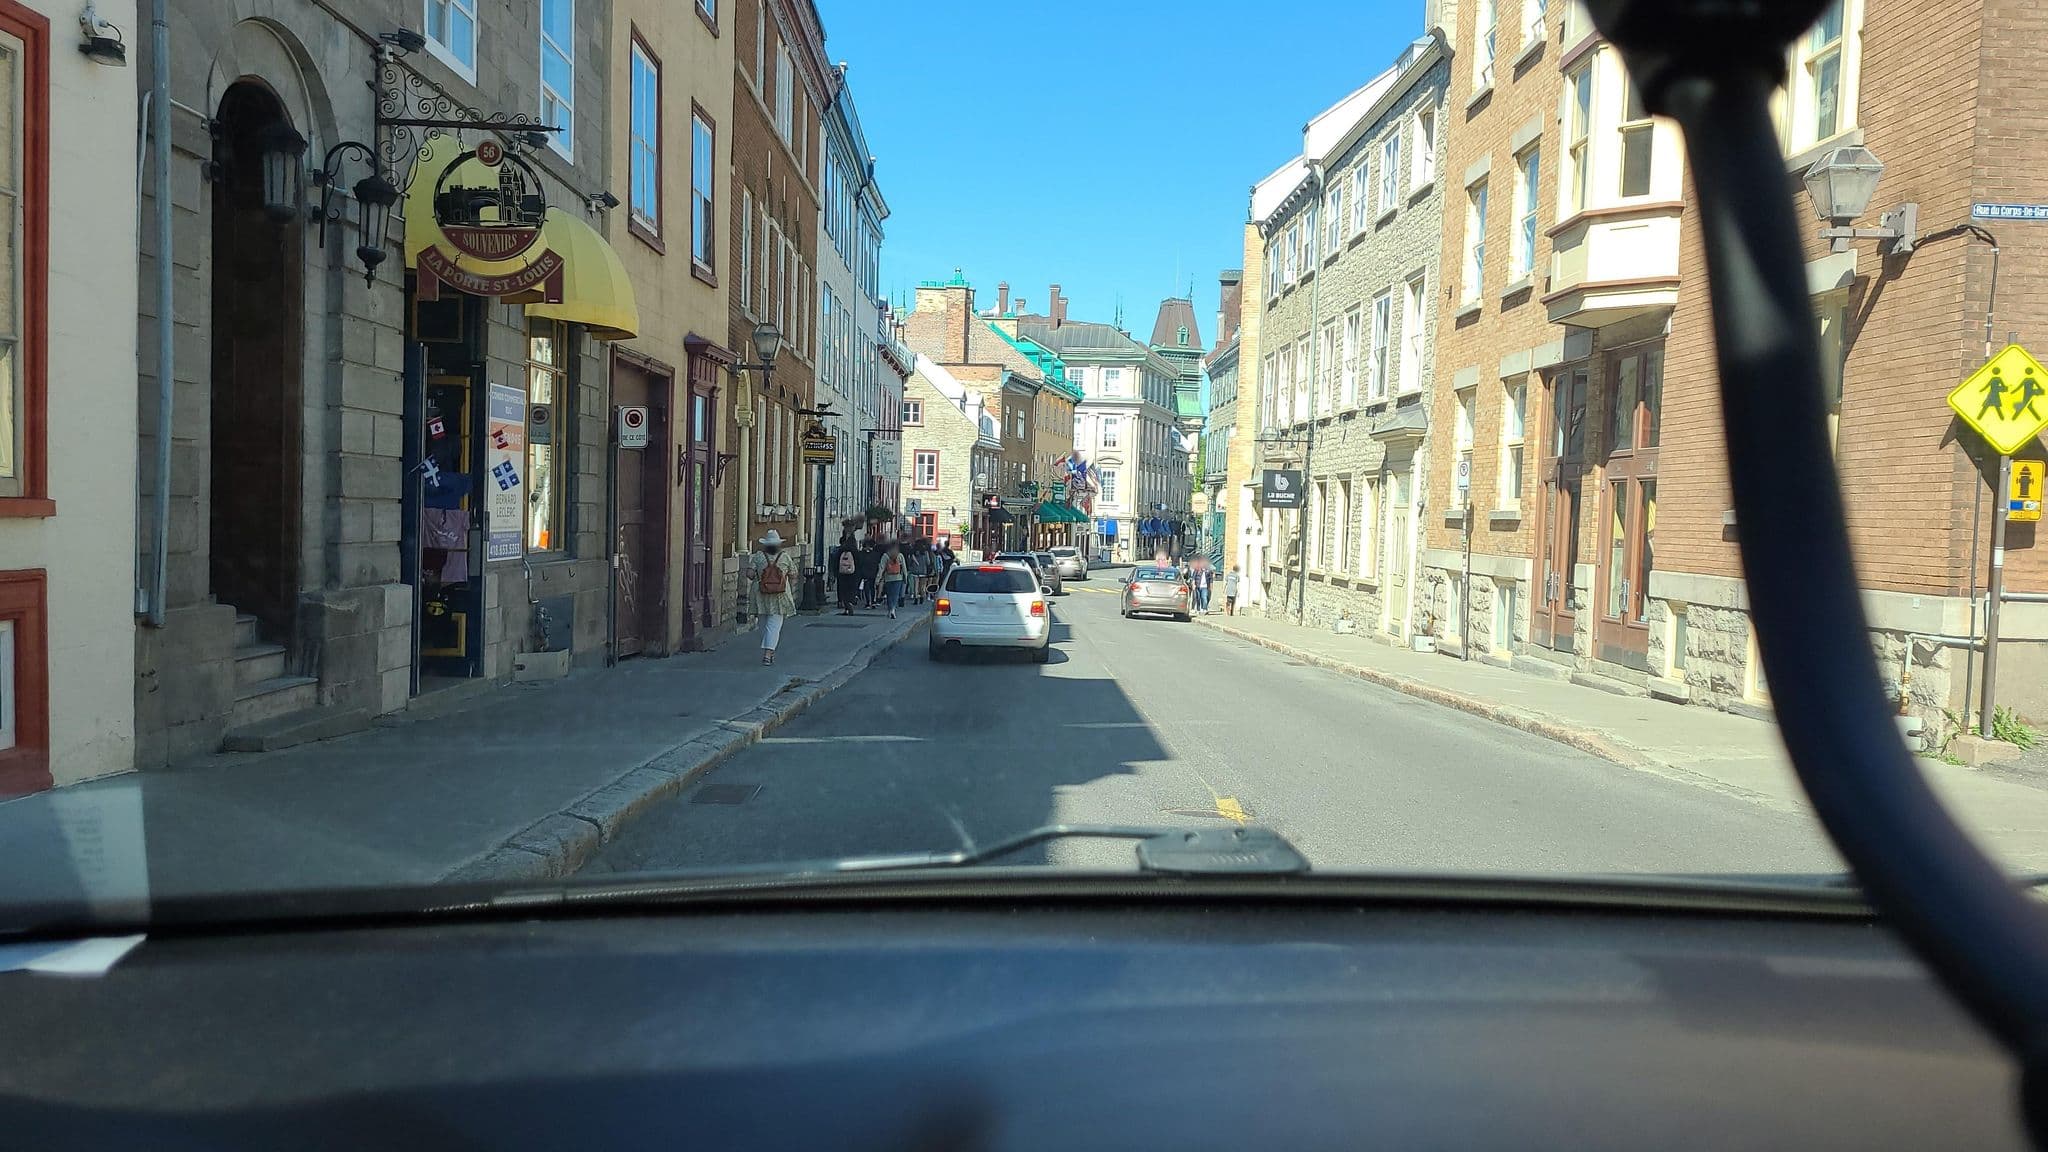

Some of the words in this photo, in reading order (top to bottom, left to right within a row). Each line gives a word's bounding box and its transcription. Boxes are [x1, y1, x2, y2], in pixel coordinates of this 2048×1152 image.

[483, 146, 495, 158] 56
[1976, 205, 1990, 215] Rue
[1990, 205, 2000, 216] du
[2001, 206, 2048, 217] Corps-De-Gar
[463, 232, 518, 254] SOUVENIRS
[426, 251, 441, 271] LA
[444, 267, 489, 292] PORTE
[495, 493, 517, 505] BERNARD
[496, 506, 516, 518] LECLERC
